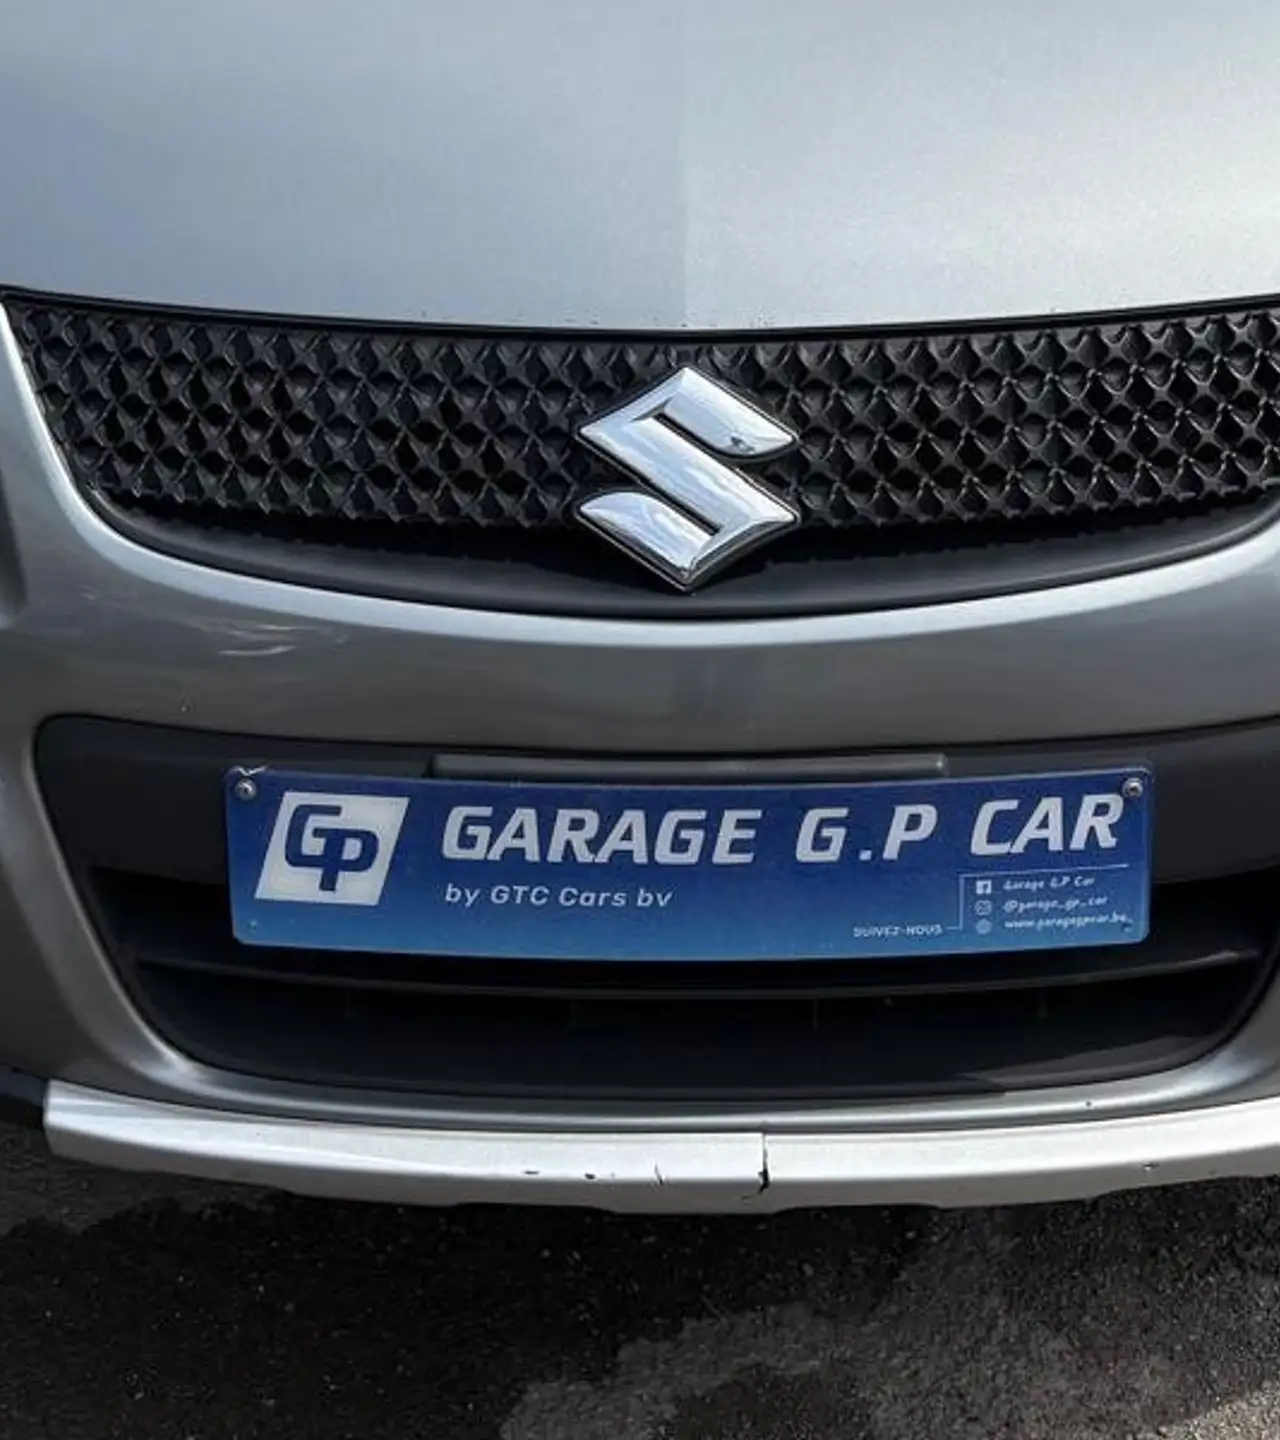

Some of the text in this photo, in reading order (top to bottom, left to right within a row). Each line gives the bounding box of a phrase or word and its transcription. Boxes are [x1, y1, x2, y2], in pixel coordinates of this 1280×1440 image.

[284, 803, 381, 892] GP
[441, 793, 1125, 866] GARAGE G.P CAR
[445, 884, 673, 908] by GTC Cars bv
